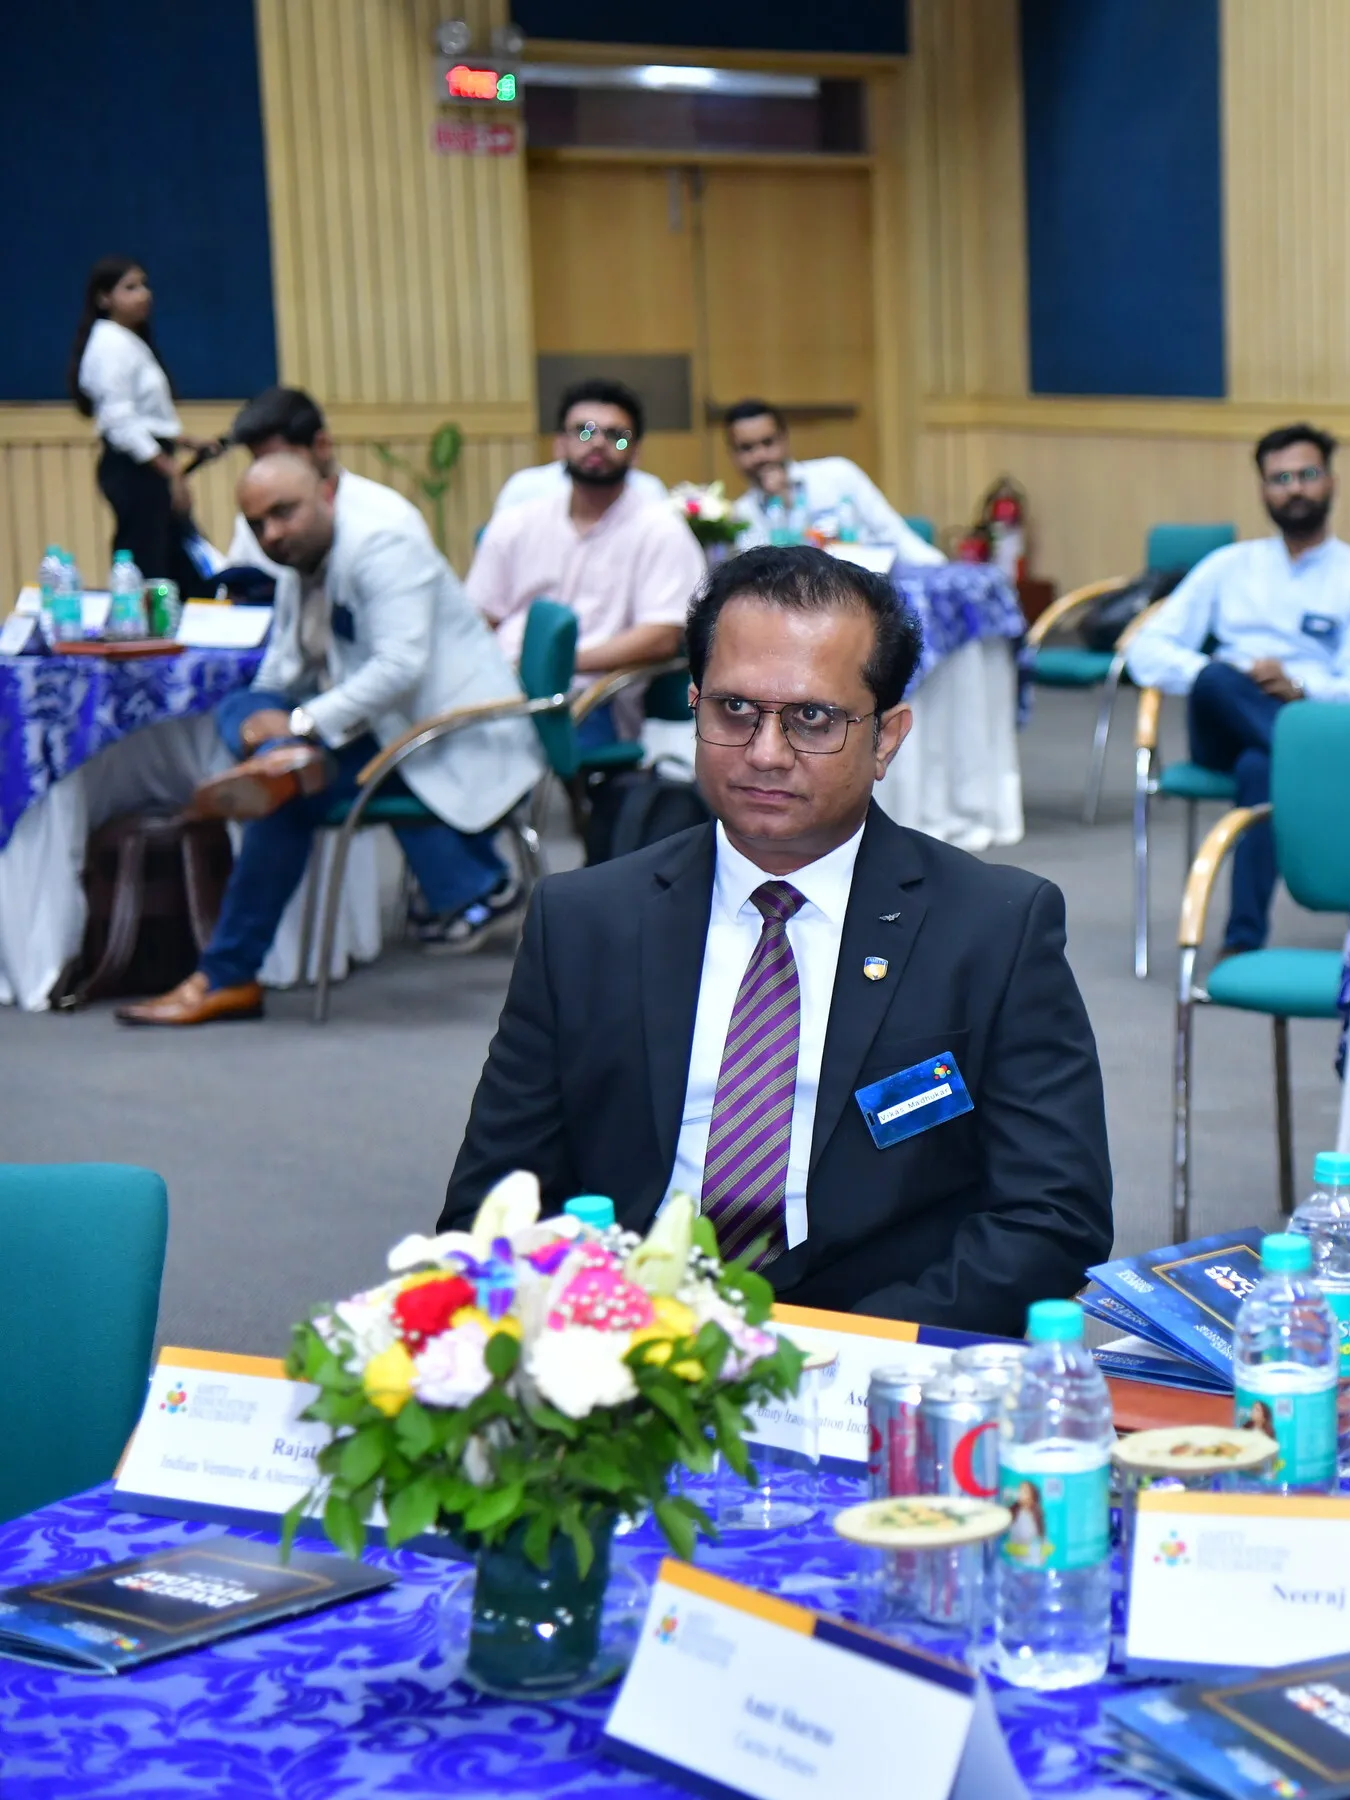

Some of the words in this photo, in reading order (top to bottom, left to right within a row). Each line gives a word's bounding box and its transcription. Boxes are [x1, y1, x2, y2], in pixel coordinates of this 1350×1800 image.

[880, 1107, 905, 1122] Vikas
[907, 1087, 950, 1109] Madhukar
[272, 1438, 316, 1461] Rajat
[1272, 1583, 1345, 1610] Neeraj
